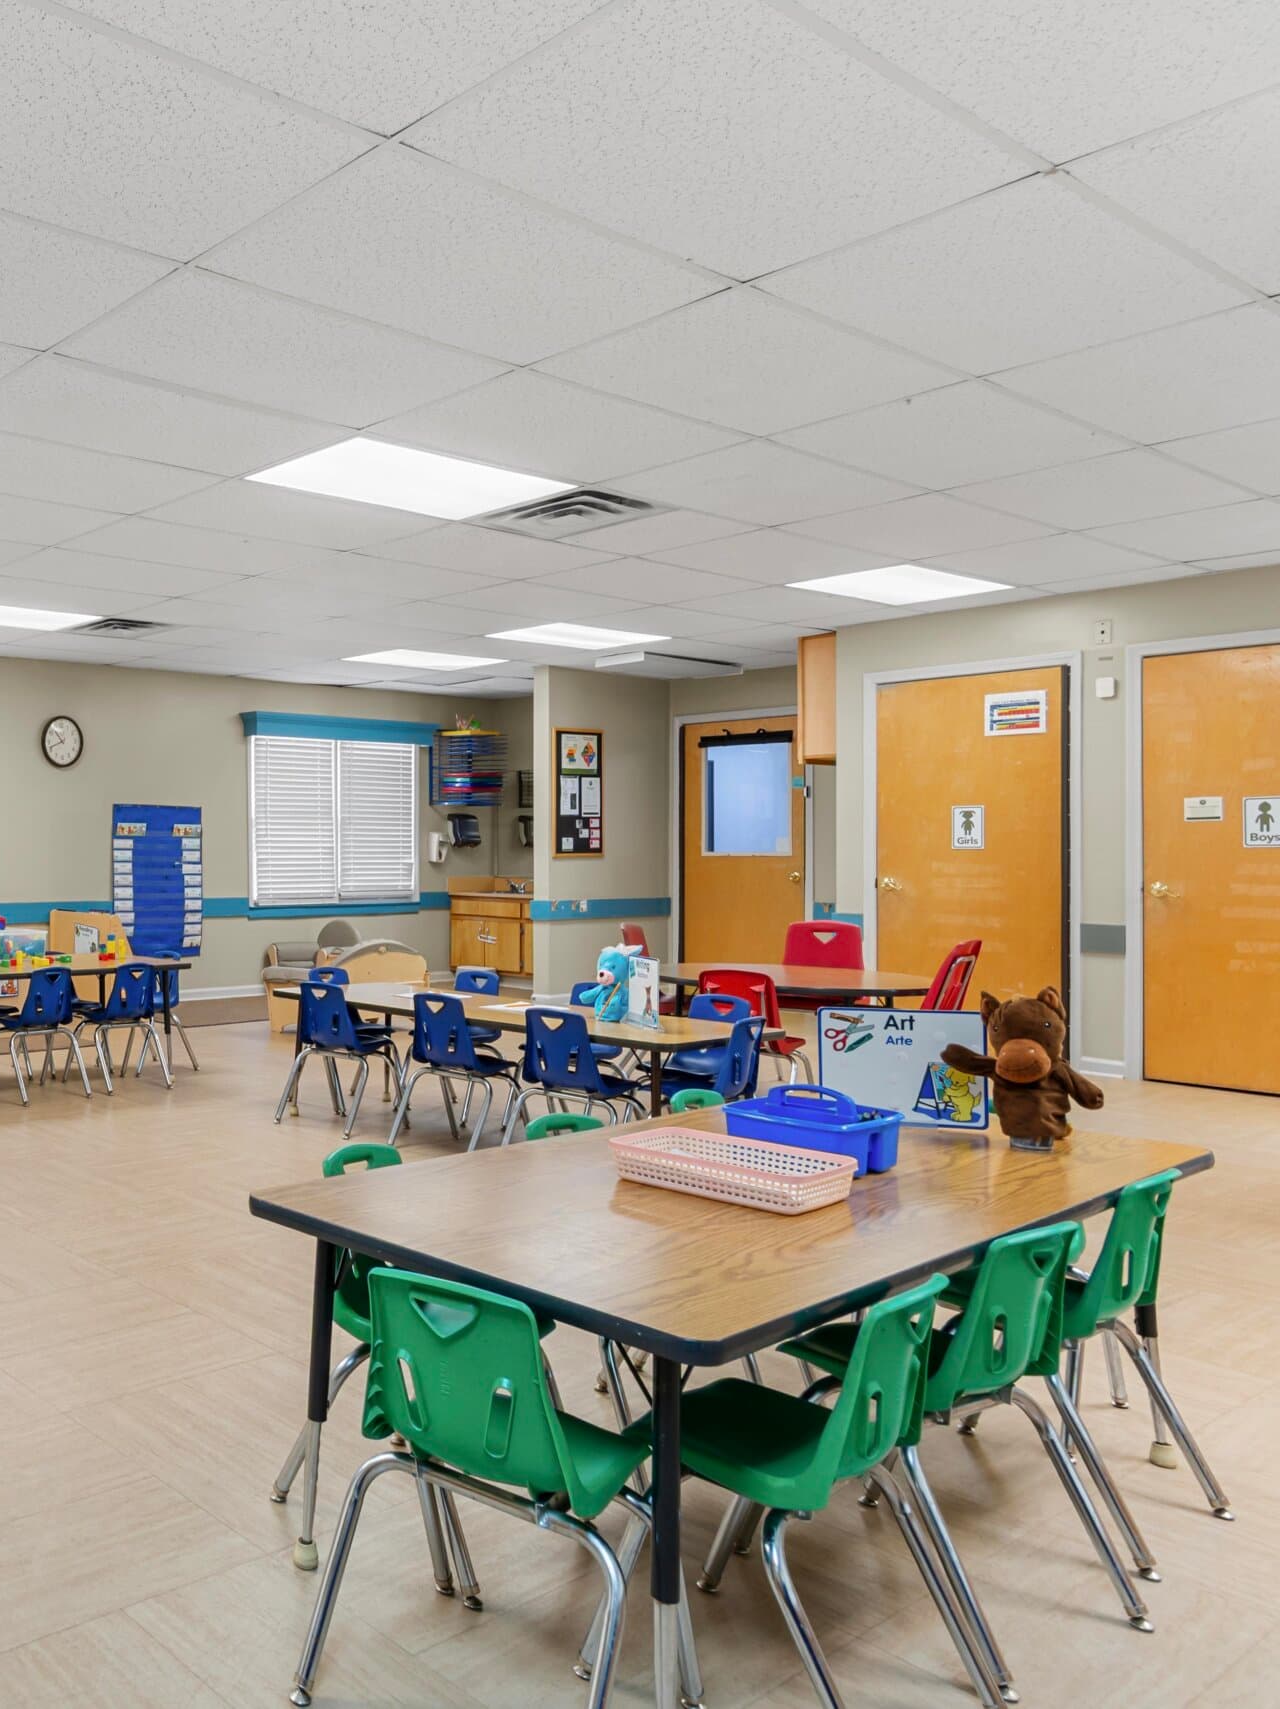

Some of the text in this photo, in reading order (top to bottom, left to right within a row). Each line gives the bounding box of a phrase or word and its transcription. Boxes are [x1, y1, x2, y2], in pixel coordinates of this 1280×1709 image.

[957, 836, 979, 845] Girls
[1250, 832, 1280, 844] Boys
[883, 1014, 916, 1031] Art
[885, 1035, 913, 1046] Arte
